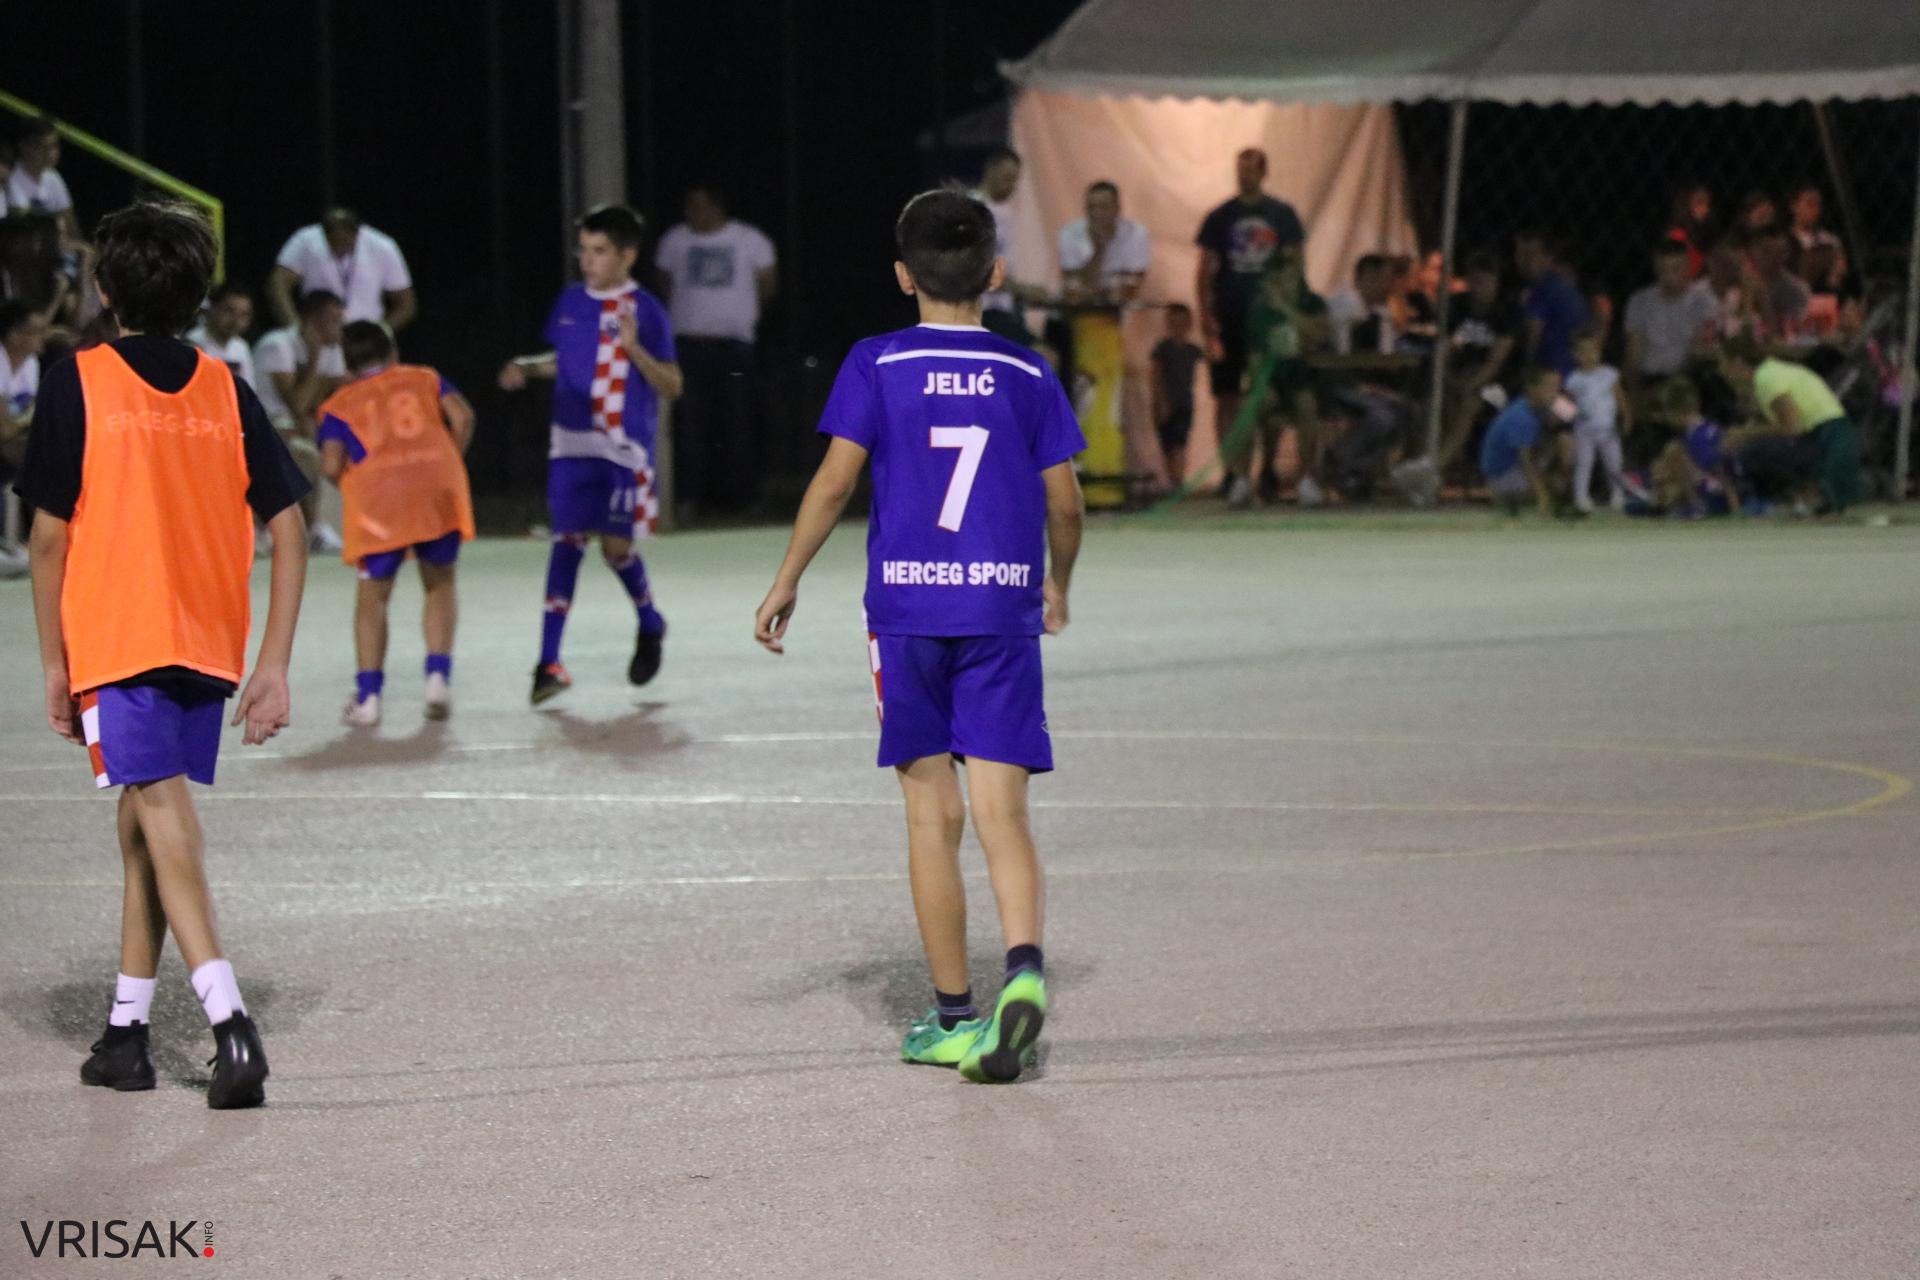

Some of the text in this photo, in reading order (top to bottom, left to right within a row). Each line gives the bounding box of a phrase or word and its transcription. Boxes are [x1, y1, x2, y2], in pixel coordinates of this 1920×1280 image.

[923, 367, 995, 396] JELIĆ
[929, 425, 990, 533] 7
[882, 560, 1031, 588] HERCEG SPORT
